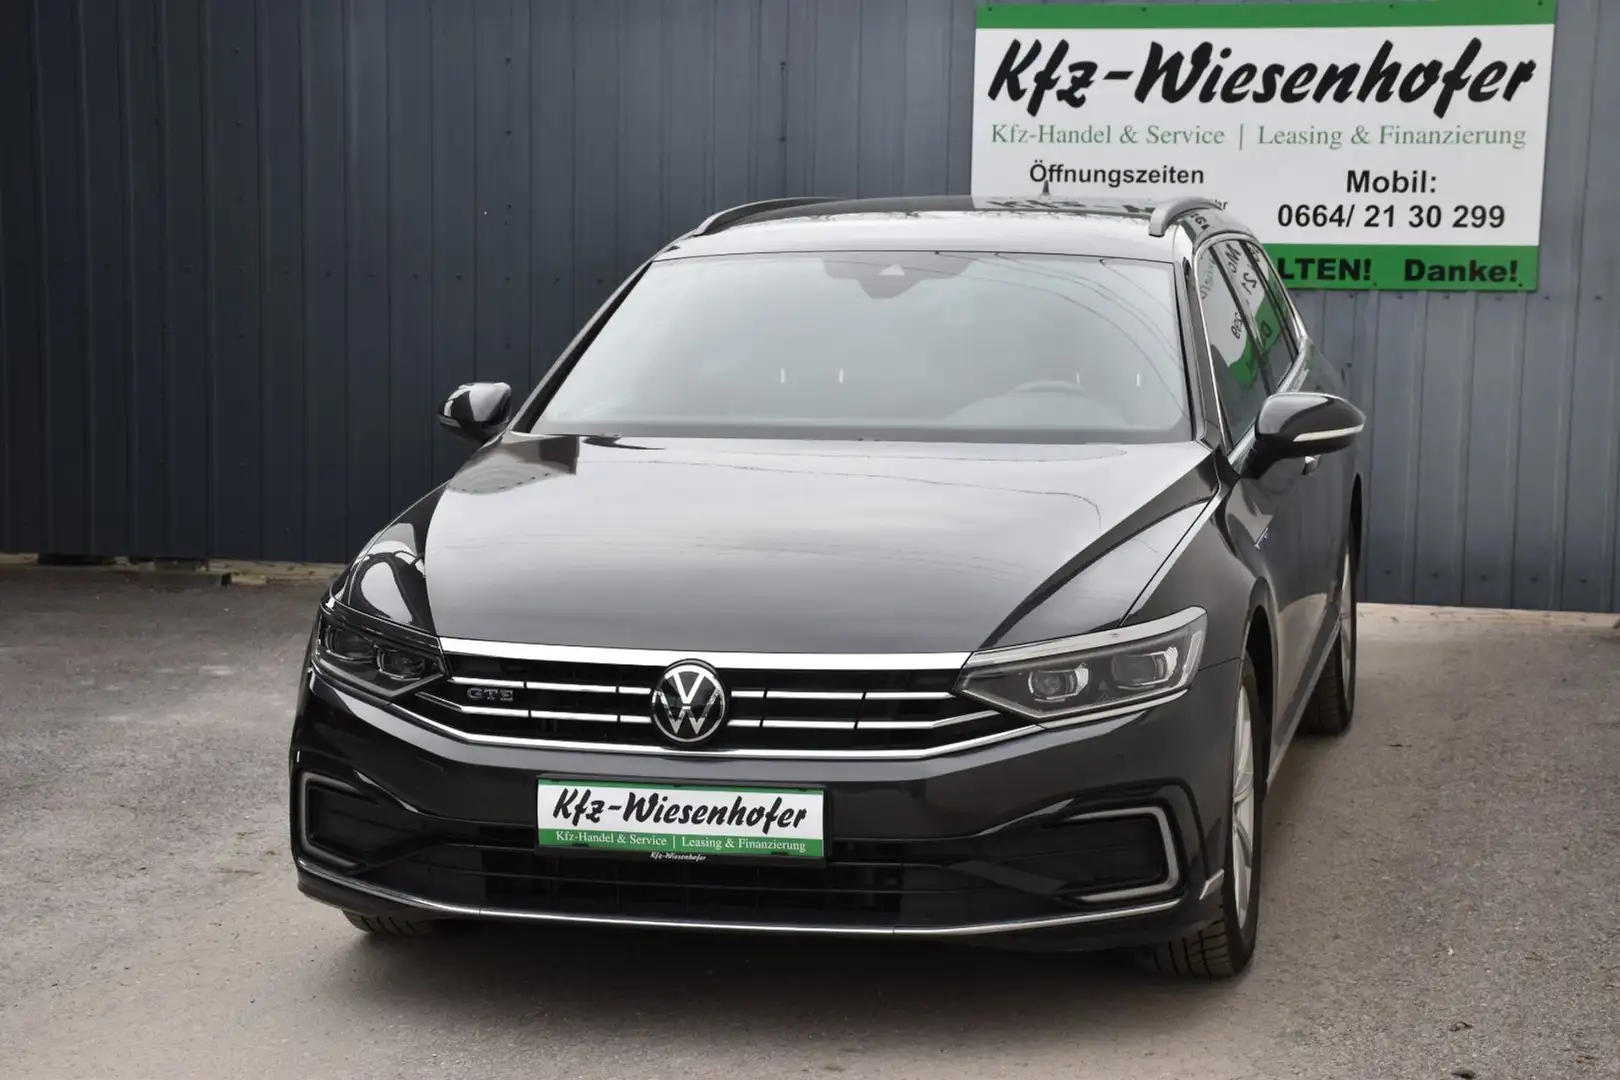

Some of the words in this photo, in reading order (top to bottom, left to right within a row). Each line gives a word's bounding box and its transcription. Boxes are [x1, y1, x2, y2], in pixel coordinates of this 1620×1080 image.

[988, 38, 1537, 118] Kfz-Wiesenhofer
[991, 124, 1112, 144] Kfz-Handel
[1119, 125, 1138, 144] &
[1146, 124, 1226, 145] Service
[1258, 124, 1343, 150] Leasing
[1350, 125, 1372, 145] &
[1379, 124, 1527, 150] Finanzierung
[1029, 159, 1204, 188] Öffnungszeiten
[1346, 170, 1438, 194] Mobil:
[1278, 204, 1355, 228] 0664/
[1364, 204, 1394, 228] 21
[1408, 204, 1442, 228] 30
[1452, 205, 1505, 229] 299
[1277, 257, 1371, 281] LTEN!
[1404, 259, 1518, 283] Danke!
[467, 687, 513, 701] GTE
[553, 787, 807, 834] Kfz-Wiesenhofer
[555, 830, 614, 844] Kfz-Handel
[617, 833, 627, 844] &
[629, 834, 668, 846] Service
[681, 836, 722, 850] Leasing
[725, 837, 735, 848] &
[738, 838, 806, 852] Finanzierung
